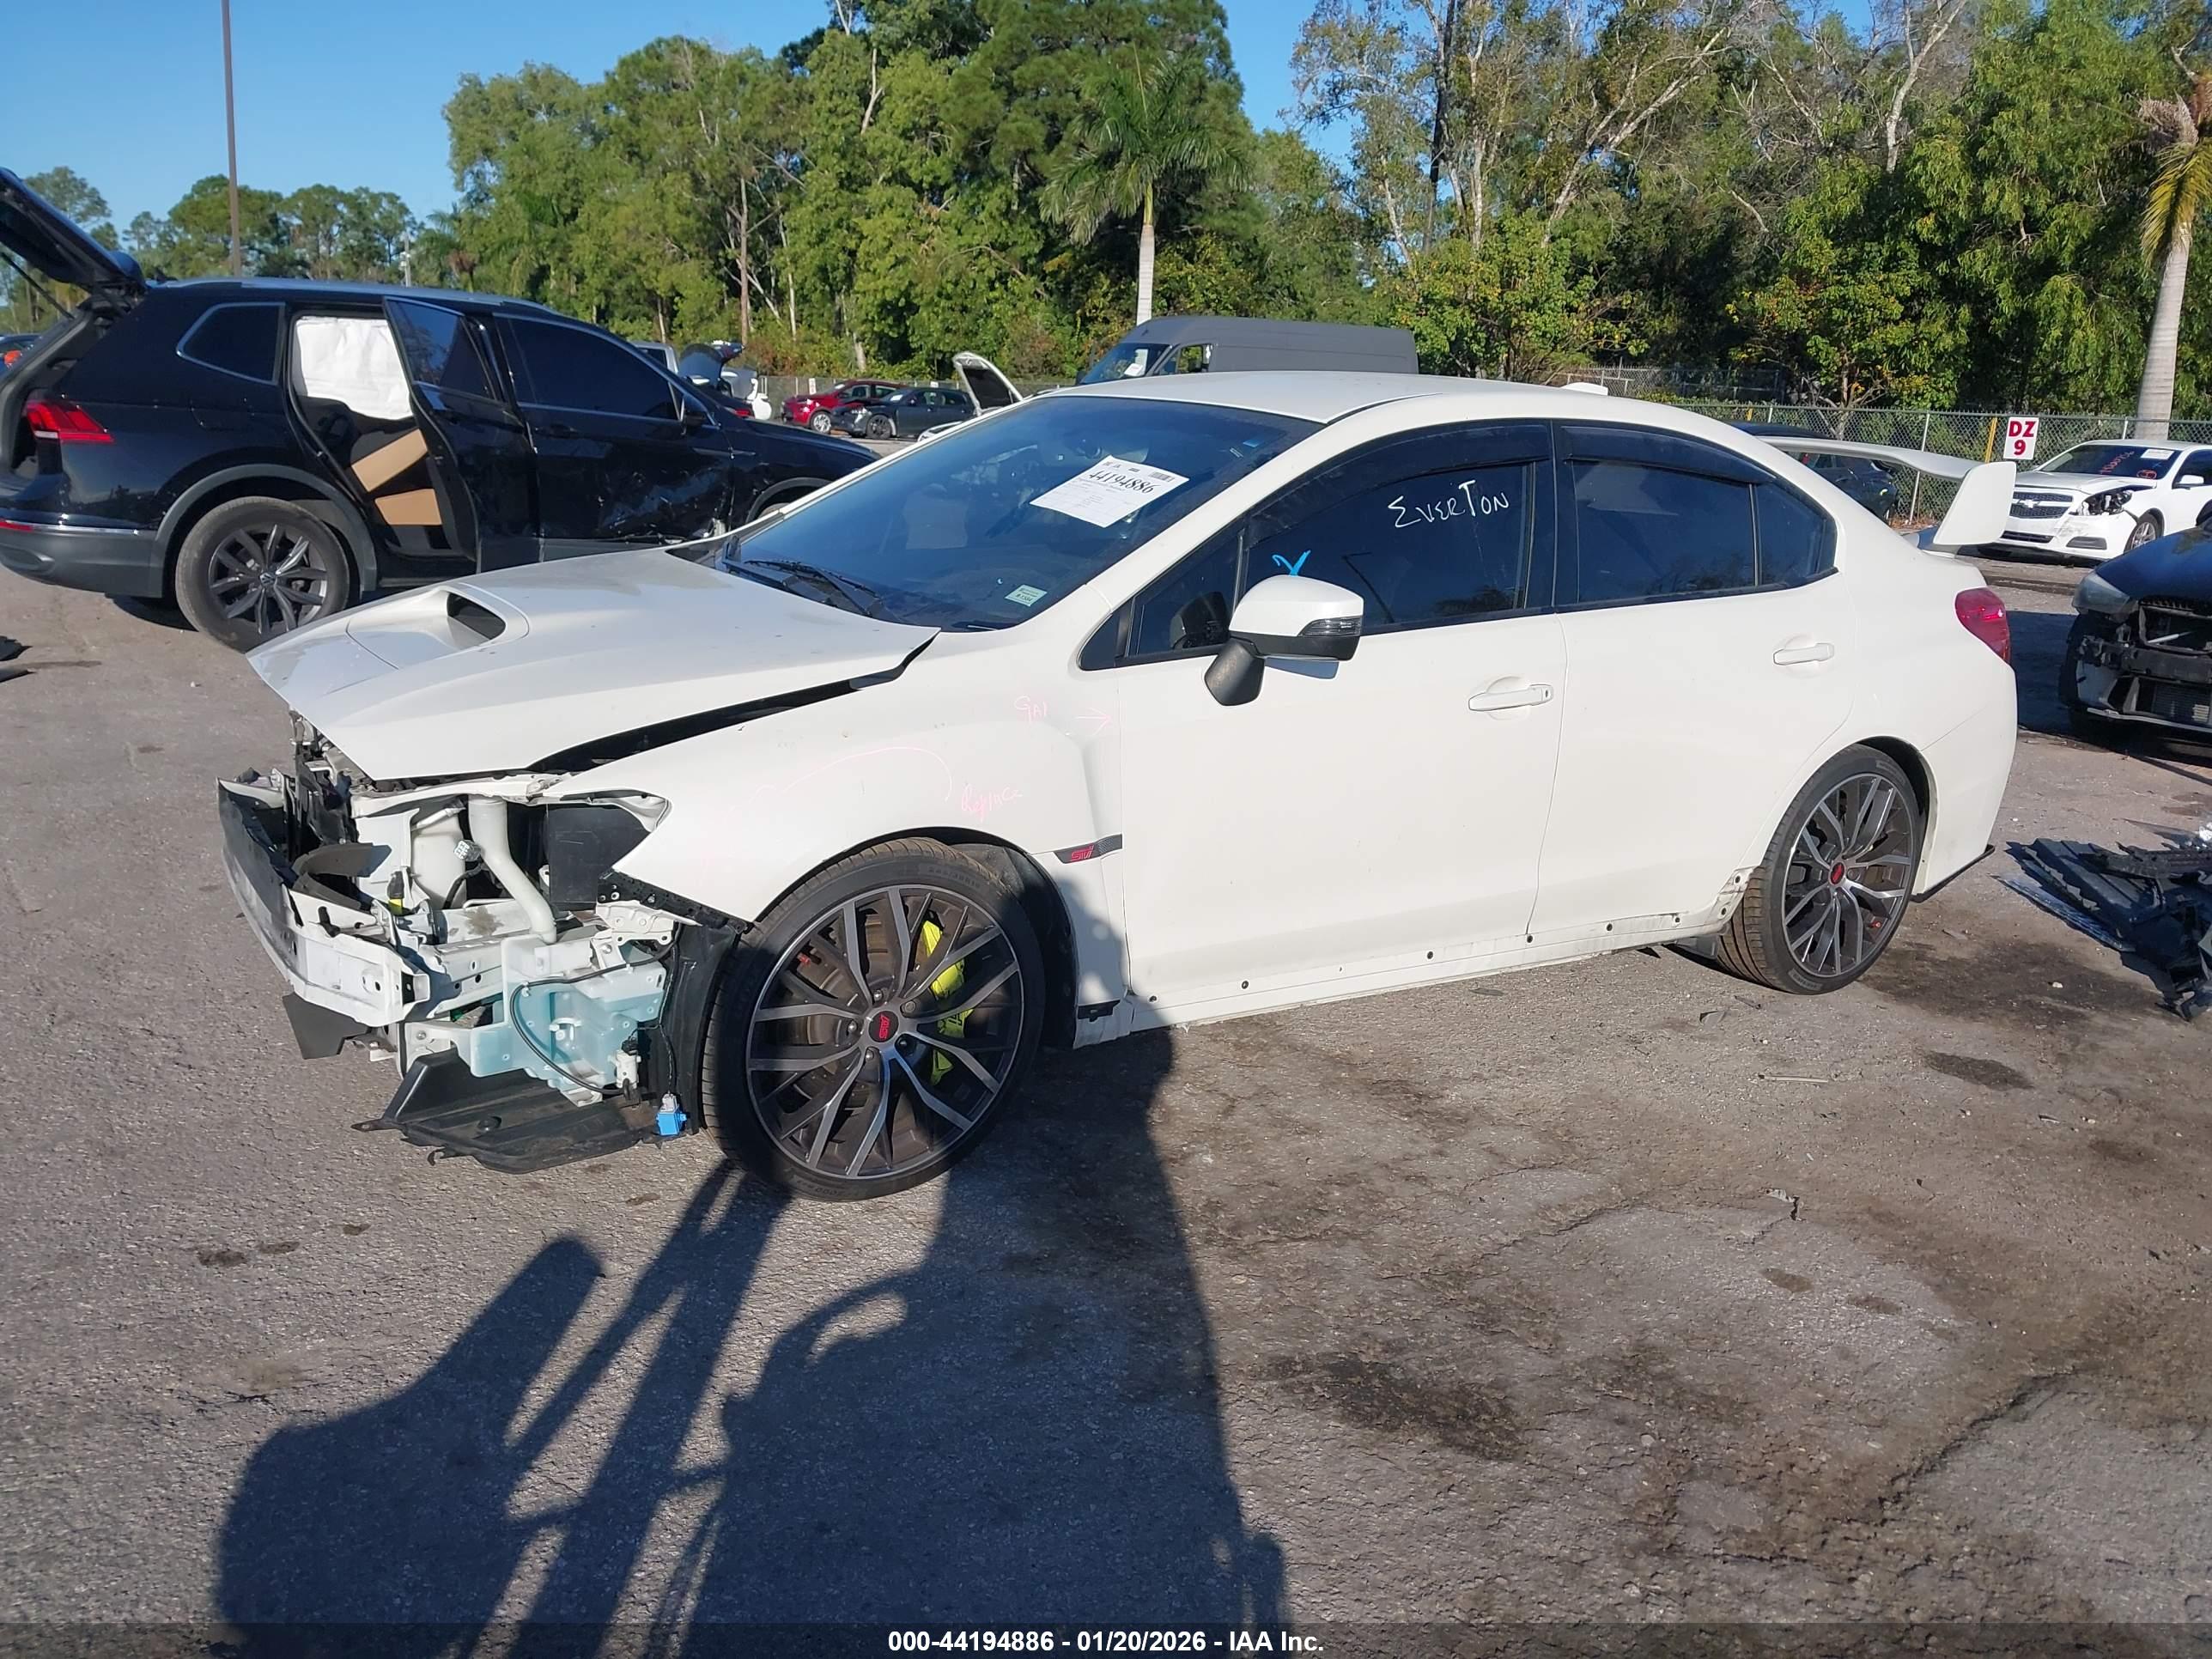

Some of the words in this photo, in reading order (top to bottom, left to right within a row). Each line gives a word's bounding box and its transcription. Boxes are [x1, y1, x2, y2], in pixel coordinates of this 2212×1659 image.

[2008, 420, 2037, 438] DZ
[2014, 439, 2027, 456] 9
[1088, 469, 1161, 495] 44194886
